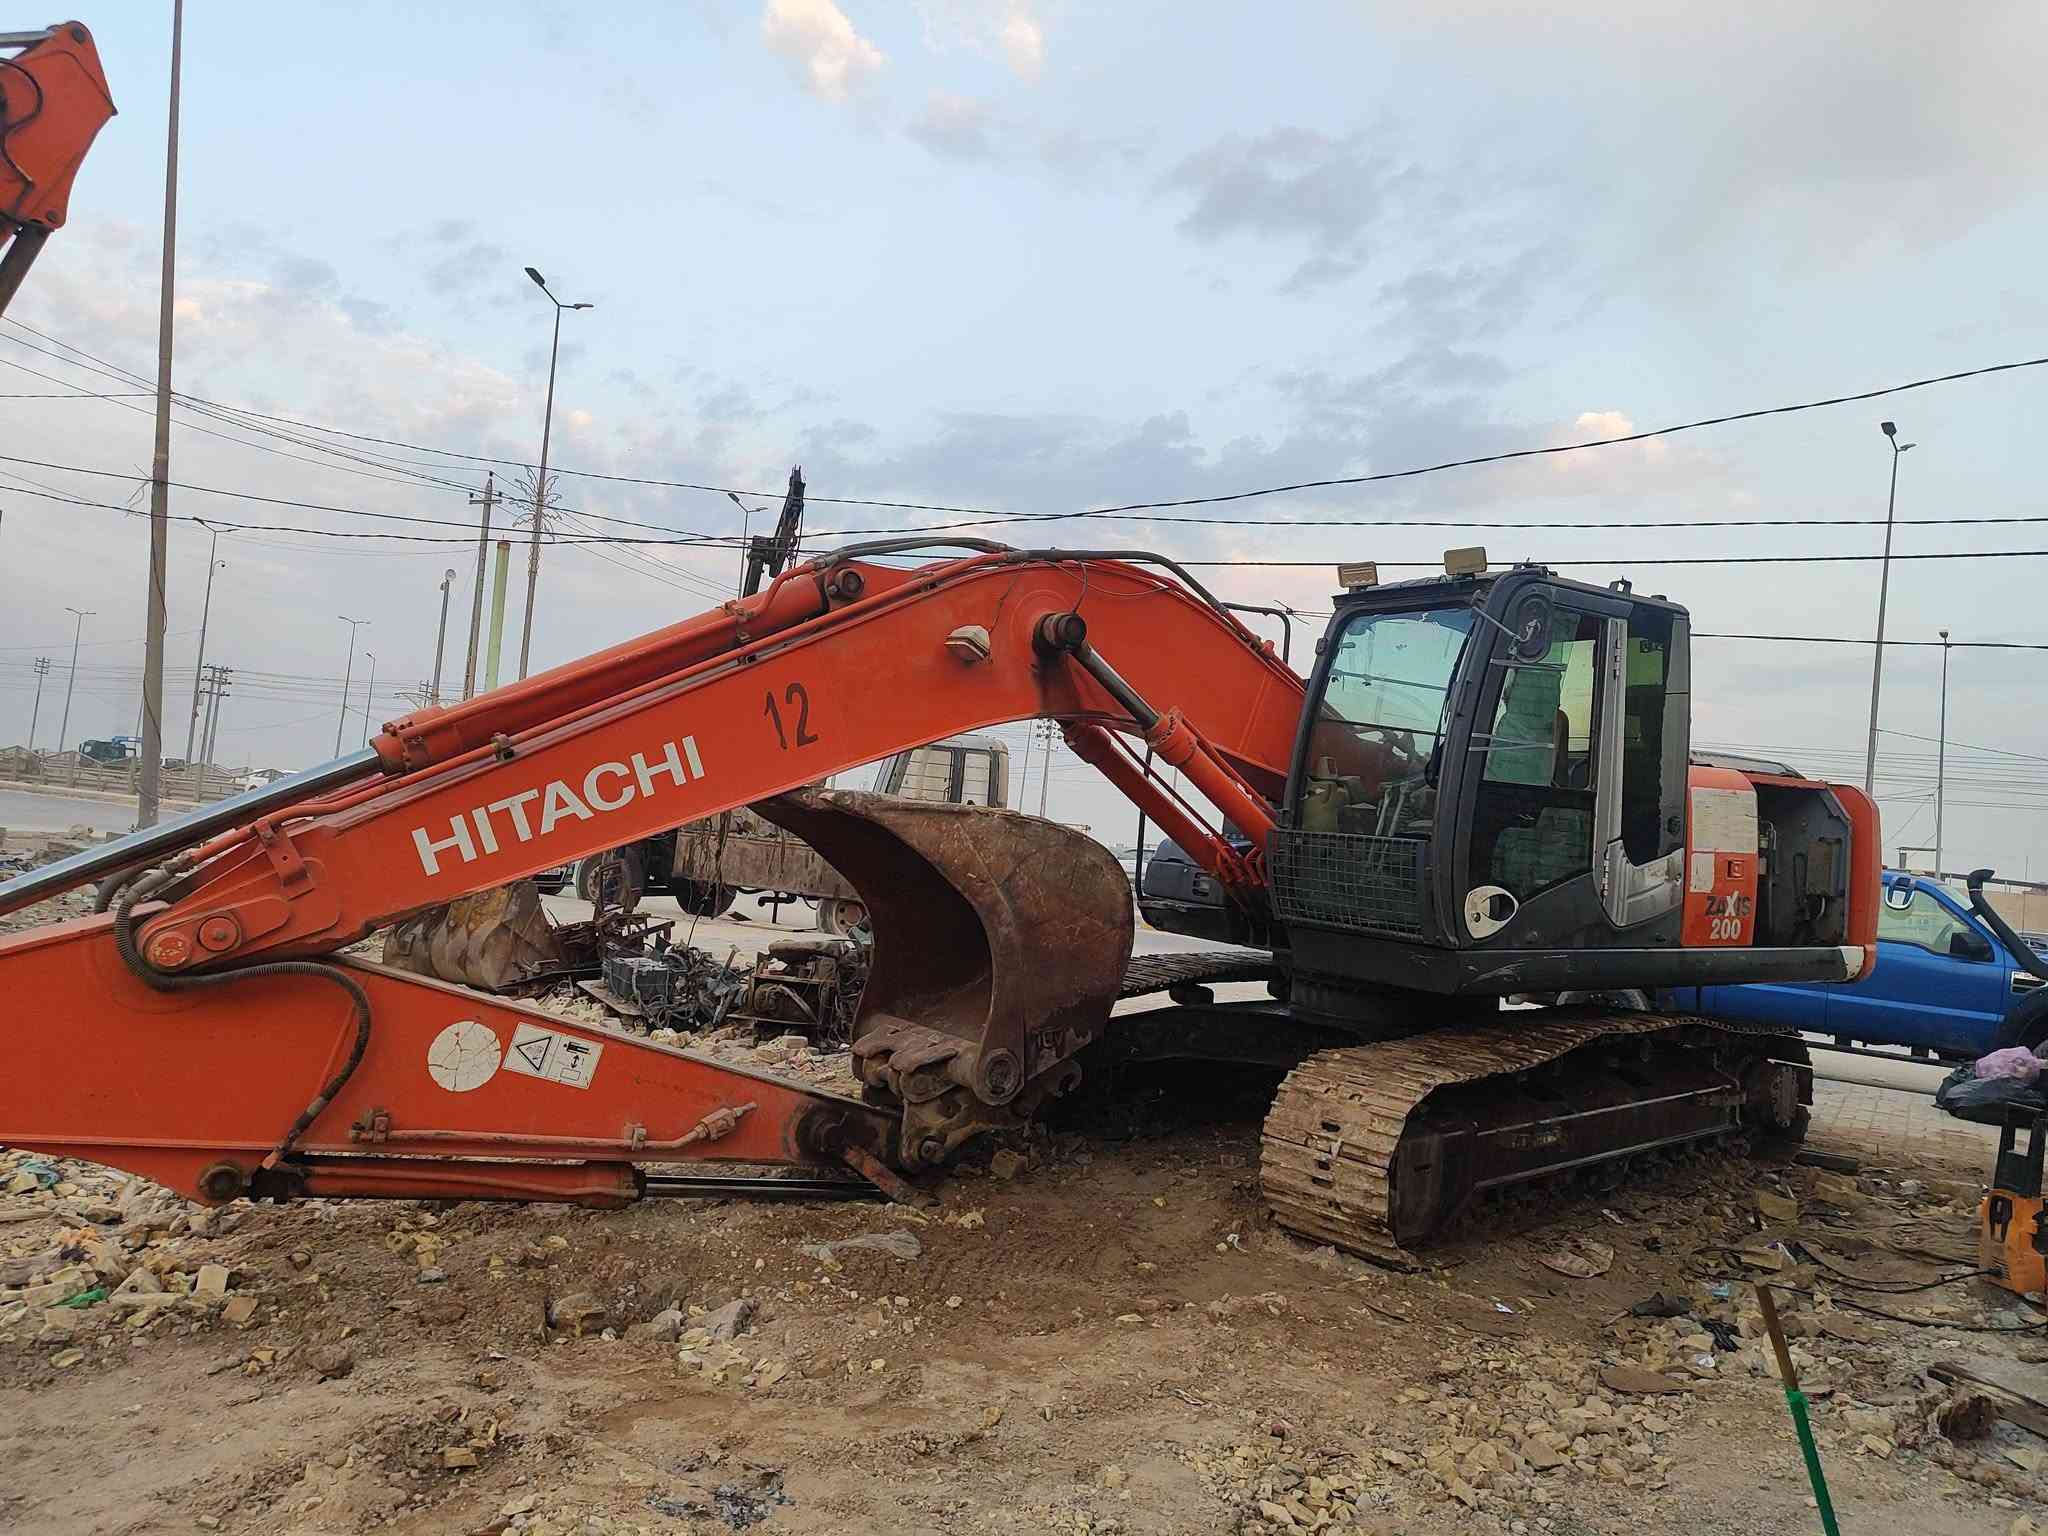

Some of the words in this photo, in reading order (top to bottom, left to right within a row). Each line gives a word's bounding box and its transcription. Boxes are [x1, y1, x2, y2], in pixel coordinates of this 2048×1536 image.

[764, 682, 818, 750] 12
[411, 735, 705, 877] HITACHI
[1705, 890, 1752, 917] ZAXIS
[1710, 918, 1742, 940] 200
